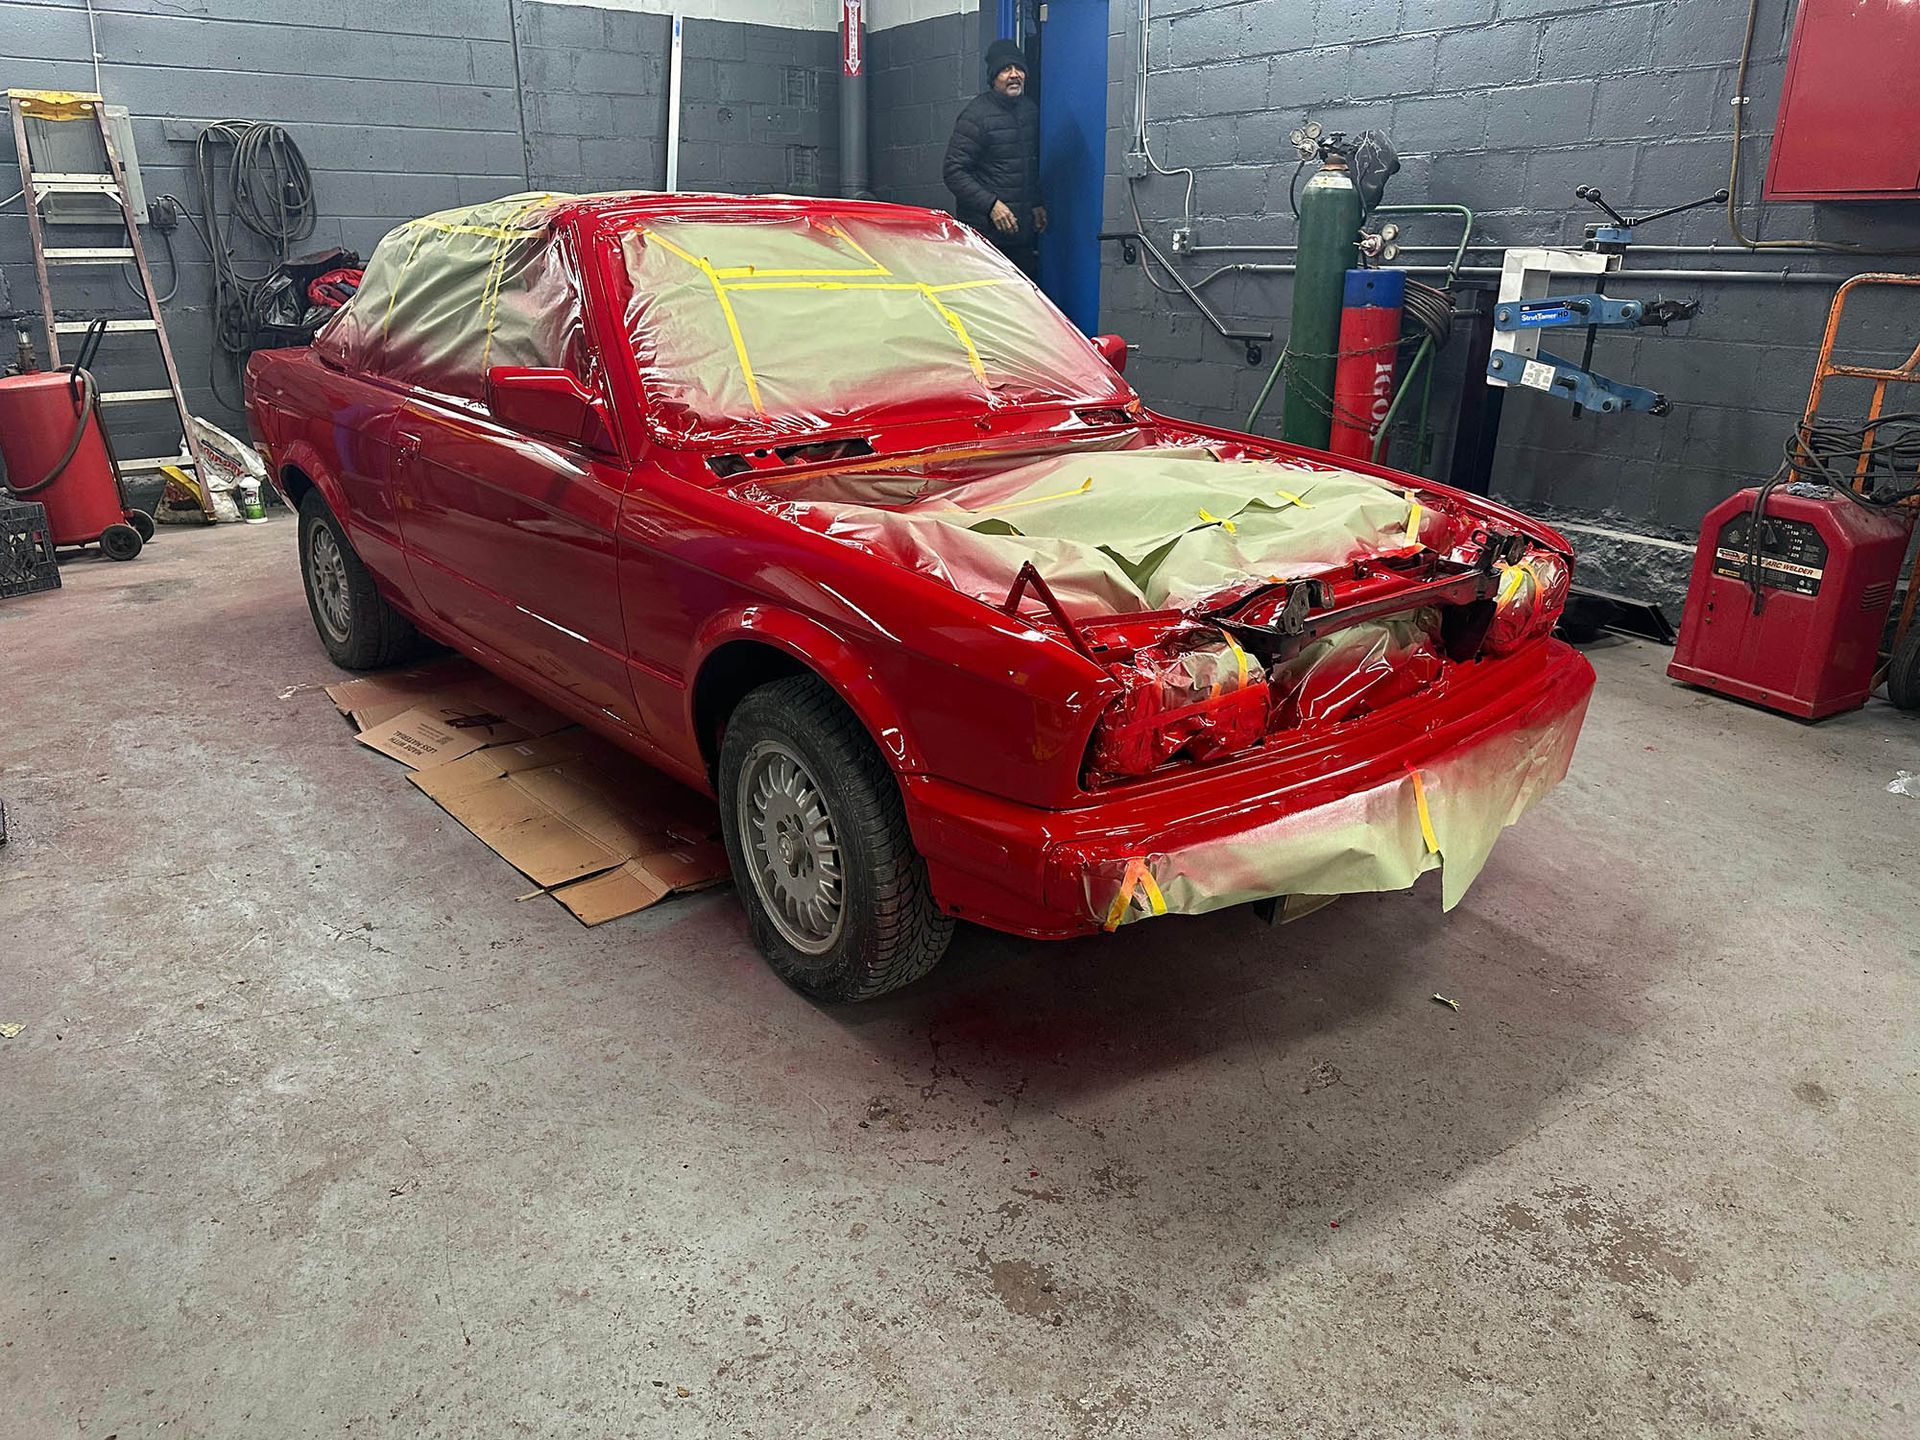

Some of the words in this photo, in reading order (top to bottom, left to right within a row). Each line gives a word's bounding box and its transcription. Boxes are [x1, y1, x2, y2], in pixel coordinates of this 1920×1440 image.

[1557, 310, 1569, 318] HD
[1765, 560, 1782, 570] ARC
[1783, 562, 1814, 576] WELDER
[392, 730, 422, 748] MATERIAL
